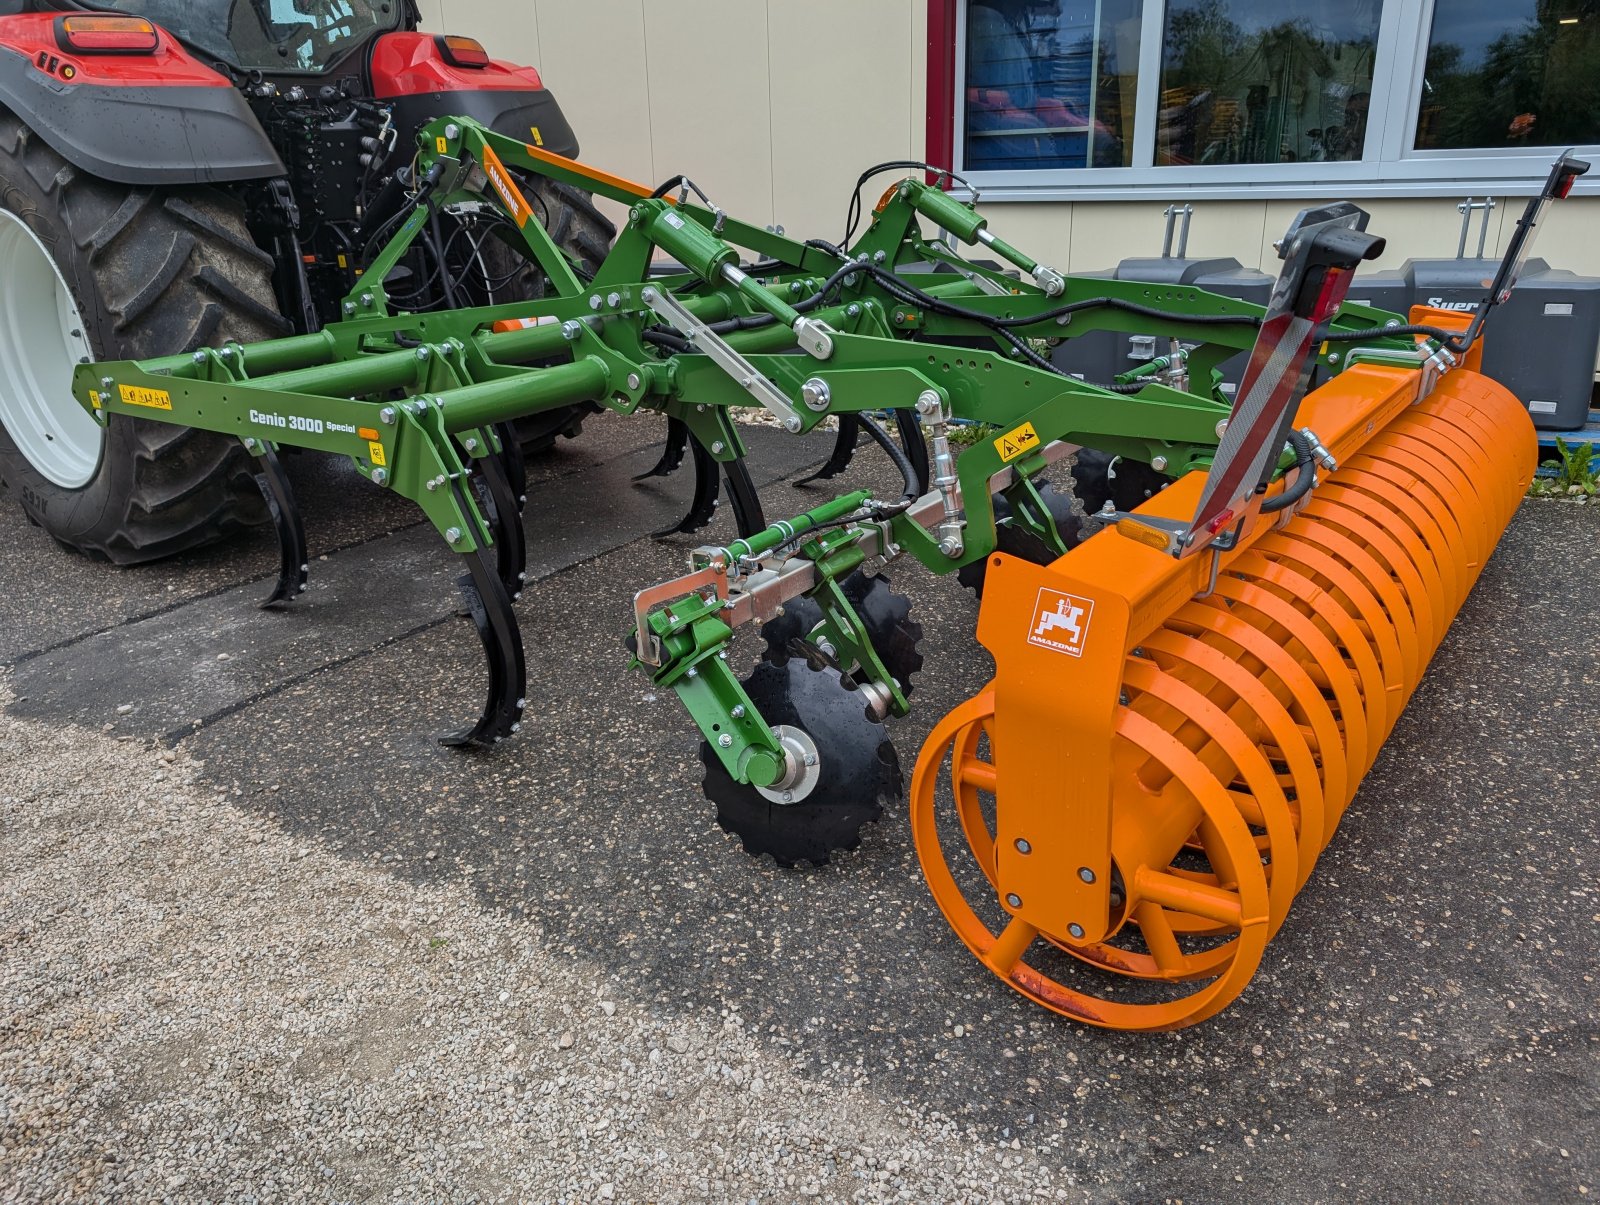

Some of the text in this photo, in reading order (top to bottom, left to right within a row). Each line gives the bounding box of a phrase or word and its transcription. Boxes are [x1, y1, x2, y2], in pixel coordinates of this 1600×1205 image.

[489, 165, 519, 216] AMAZONE
[1427, 297, 1480, 312] Suer
[250, 409, 356, 434] Cenio 3000 Special
[1030, 635, 1080, 654] AMAZONE
